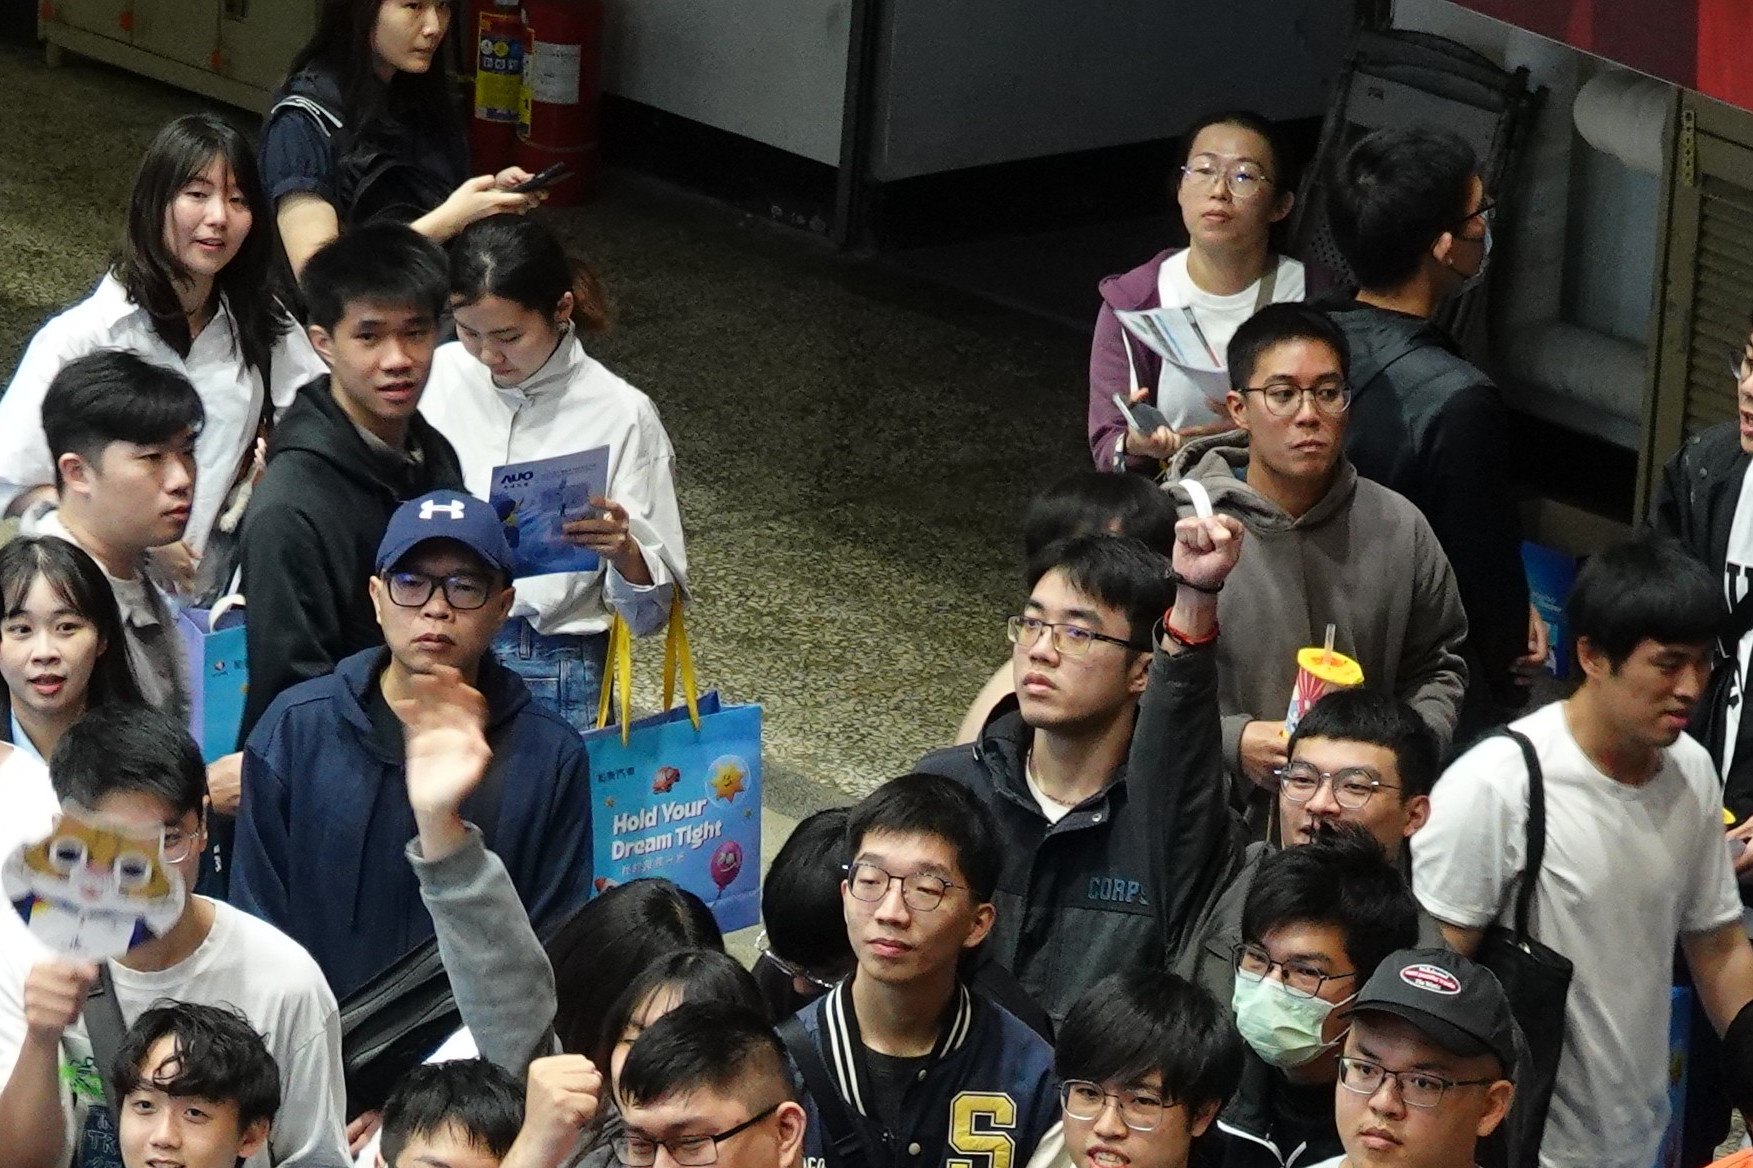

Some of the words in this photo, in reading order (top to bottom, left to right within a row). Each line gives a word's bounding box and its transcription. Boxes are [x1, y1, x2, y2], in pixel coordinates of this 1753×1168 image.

[501, 471, 534, 484] AUO
[613, 806, 659, 835] Hold
[659, 798, 708, 823] Your
[612, 832, 672, 861] Dream
[675, 819, 723, 849] Tight
